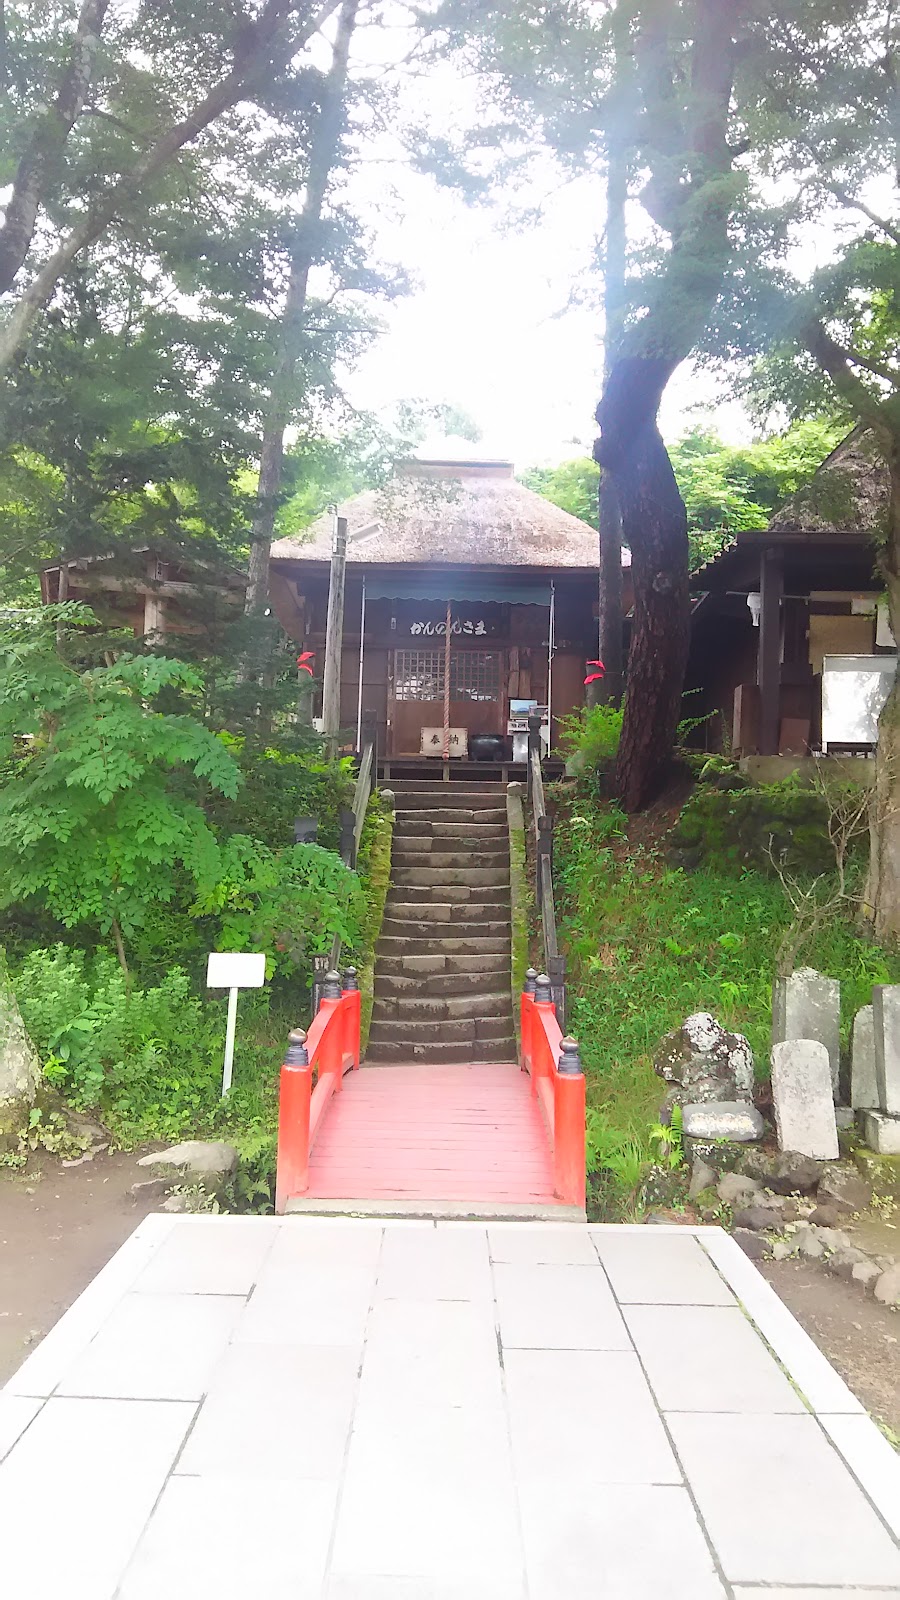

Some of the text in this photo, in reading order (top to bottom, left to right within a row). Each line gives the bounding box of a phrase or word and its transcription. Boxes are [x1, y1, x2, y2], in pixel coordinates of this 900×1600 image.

[410, 620, 487, 636] かんのんさま
